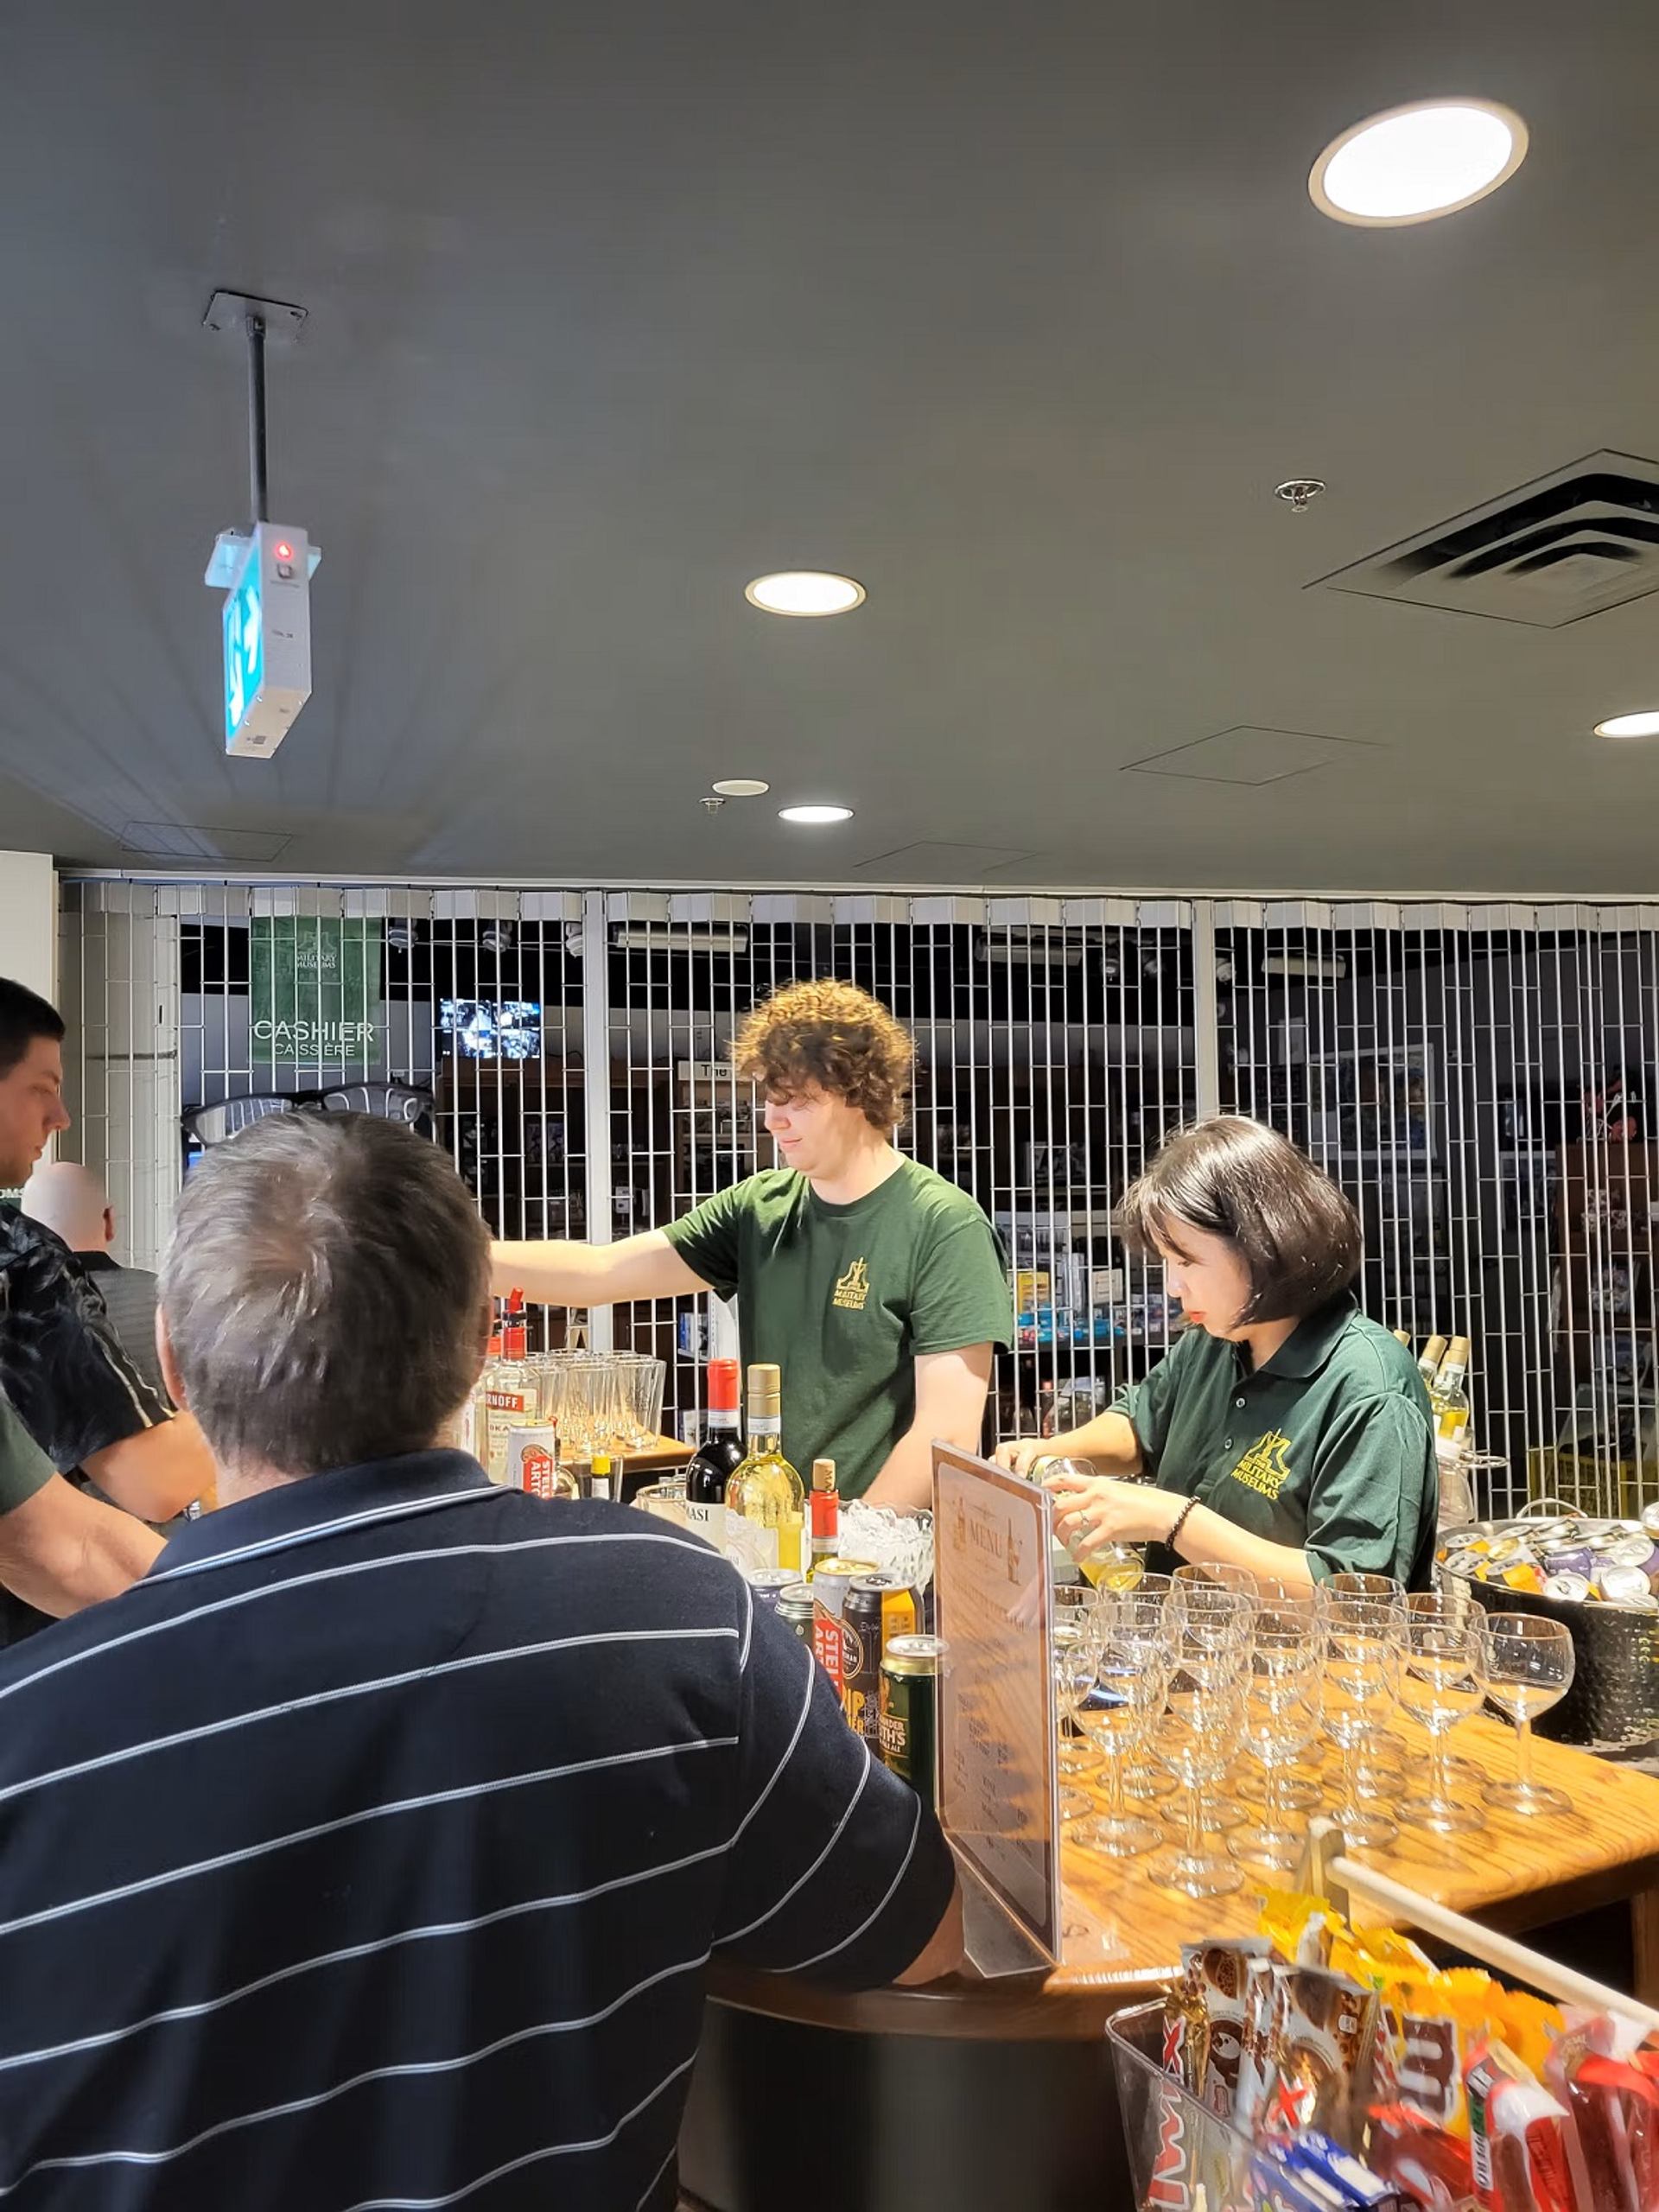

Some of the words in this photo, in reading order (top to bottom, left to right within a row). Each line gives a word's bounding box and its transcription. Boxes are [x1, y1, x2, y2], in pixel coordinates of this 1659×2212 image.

[254, 1020, 374, 1042] CASHIER
[274, 1042, 355, 1057] CASSÈRE
[1230, 1468, 1280, 1500] MUSEUMS
[1236, 1460, 1284, 1489] MILITARY
[969, 1518, 1002, 1558] MENU
